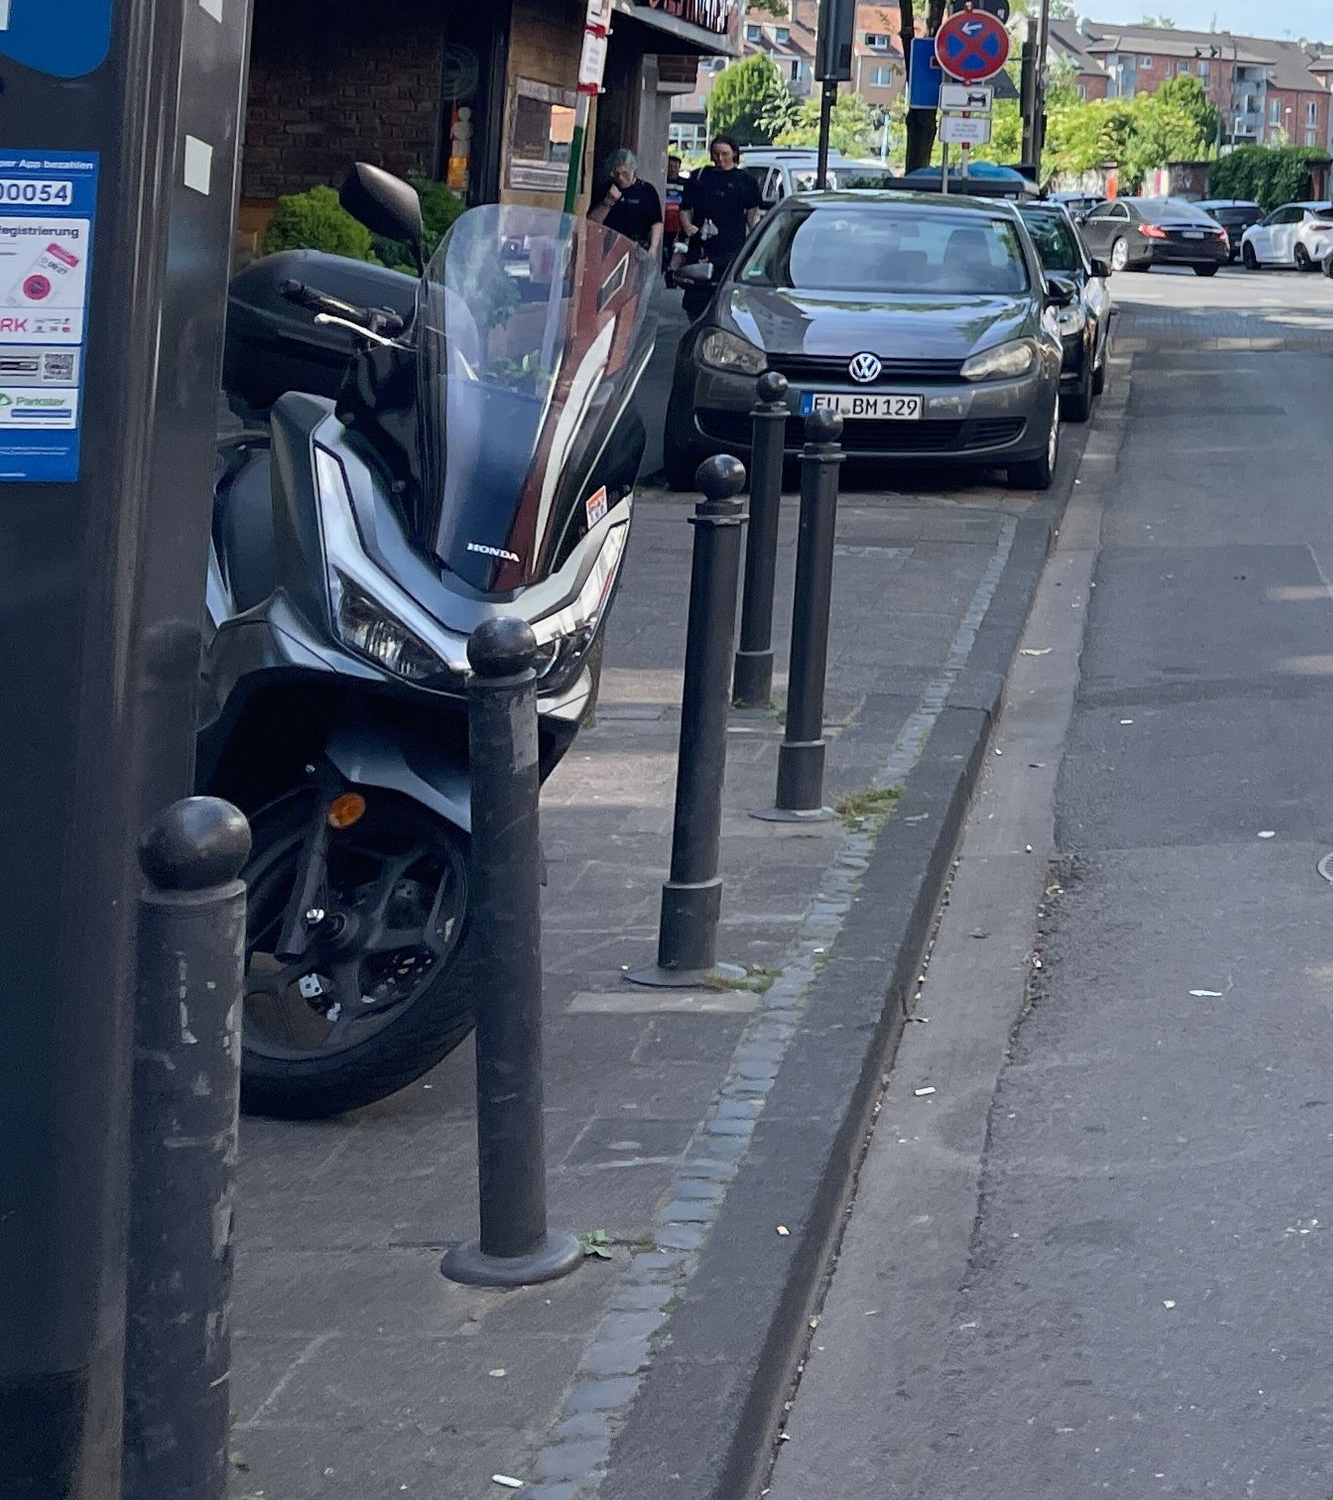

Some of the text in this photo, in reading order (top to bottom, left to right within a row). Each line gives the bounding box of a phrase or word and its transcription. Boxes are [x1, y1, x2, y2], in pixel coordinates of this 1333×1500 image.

[0, 226, 79, 239] egistrierung
[852, 398, 878, 416] BM
[881, 399, 918, 417] 129
[467, 543, 520, 562] HONDA
